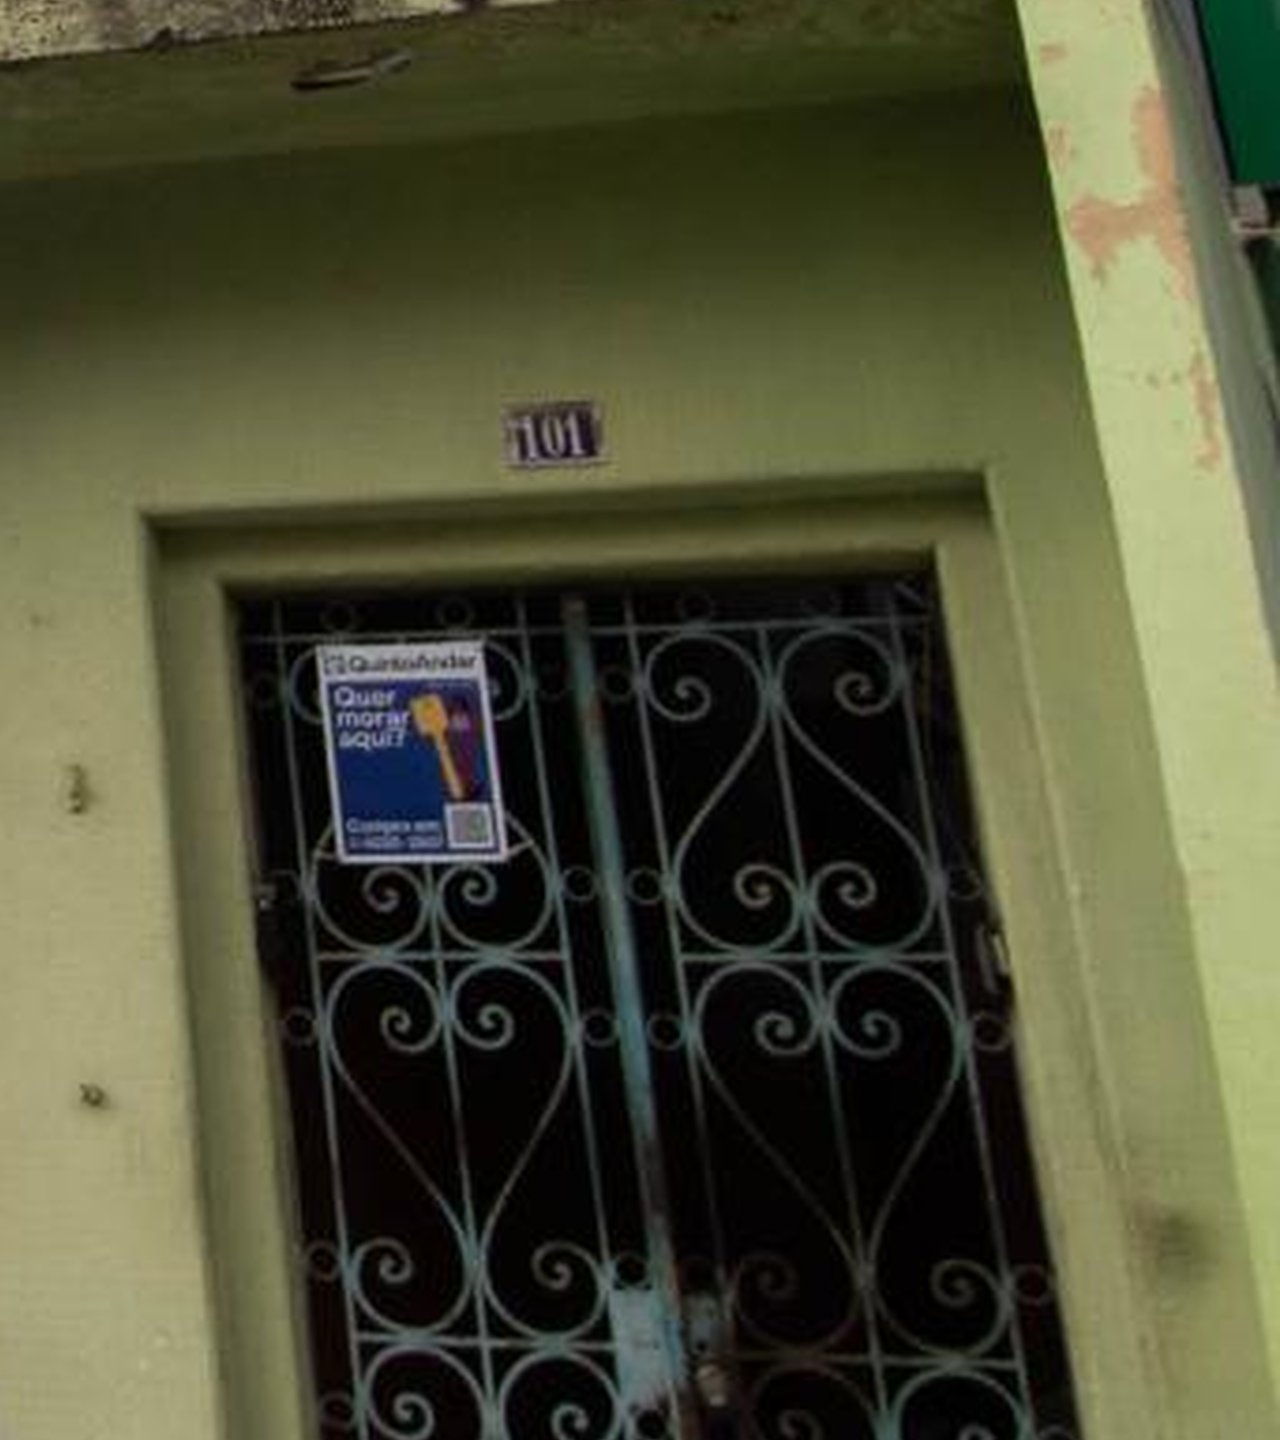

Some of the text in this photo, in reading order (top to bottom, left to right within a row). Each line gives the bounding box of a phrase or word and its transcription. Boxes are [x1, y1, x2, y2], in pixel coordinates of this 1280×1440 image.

[333, 686, 397, 708] Quer
[336, 708, 411, 728] morar
[338, 728, 407, 752] aqui?
